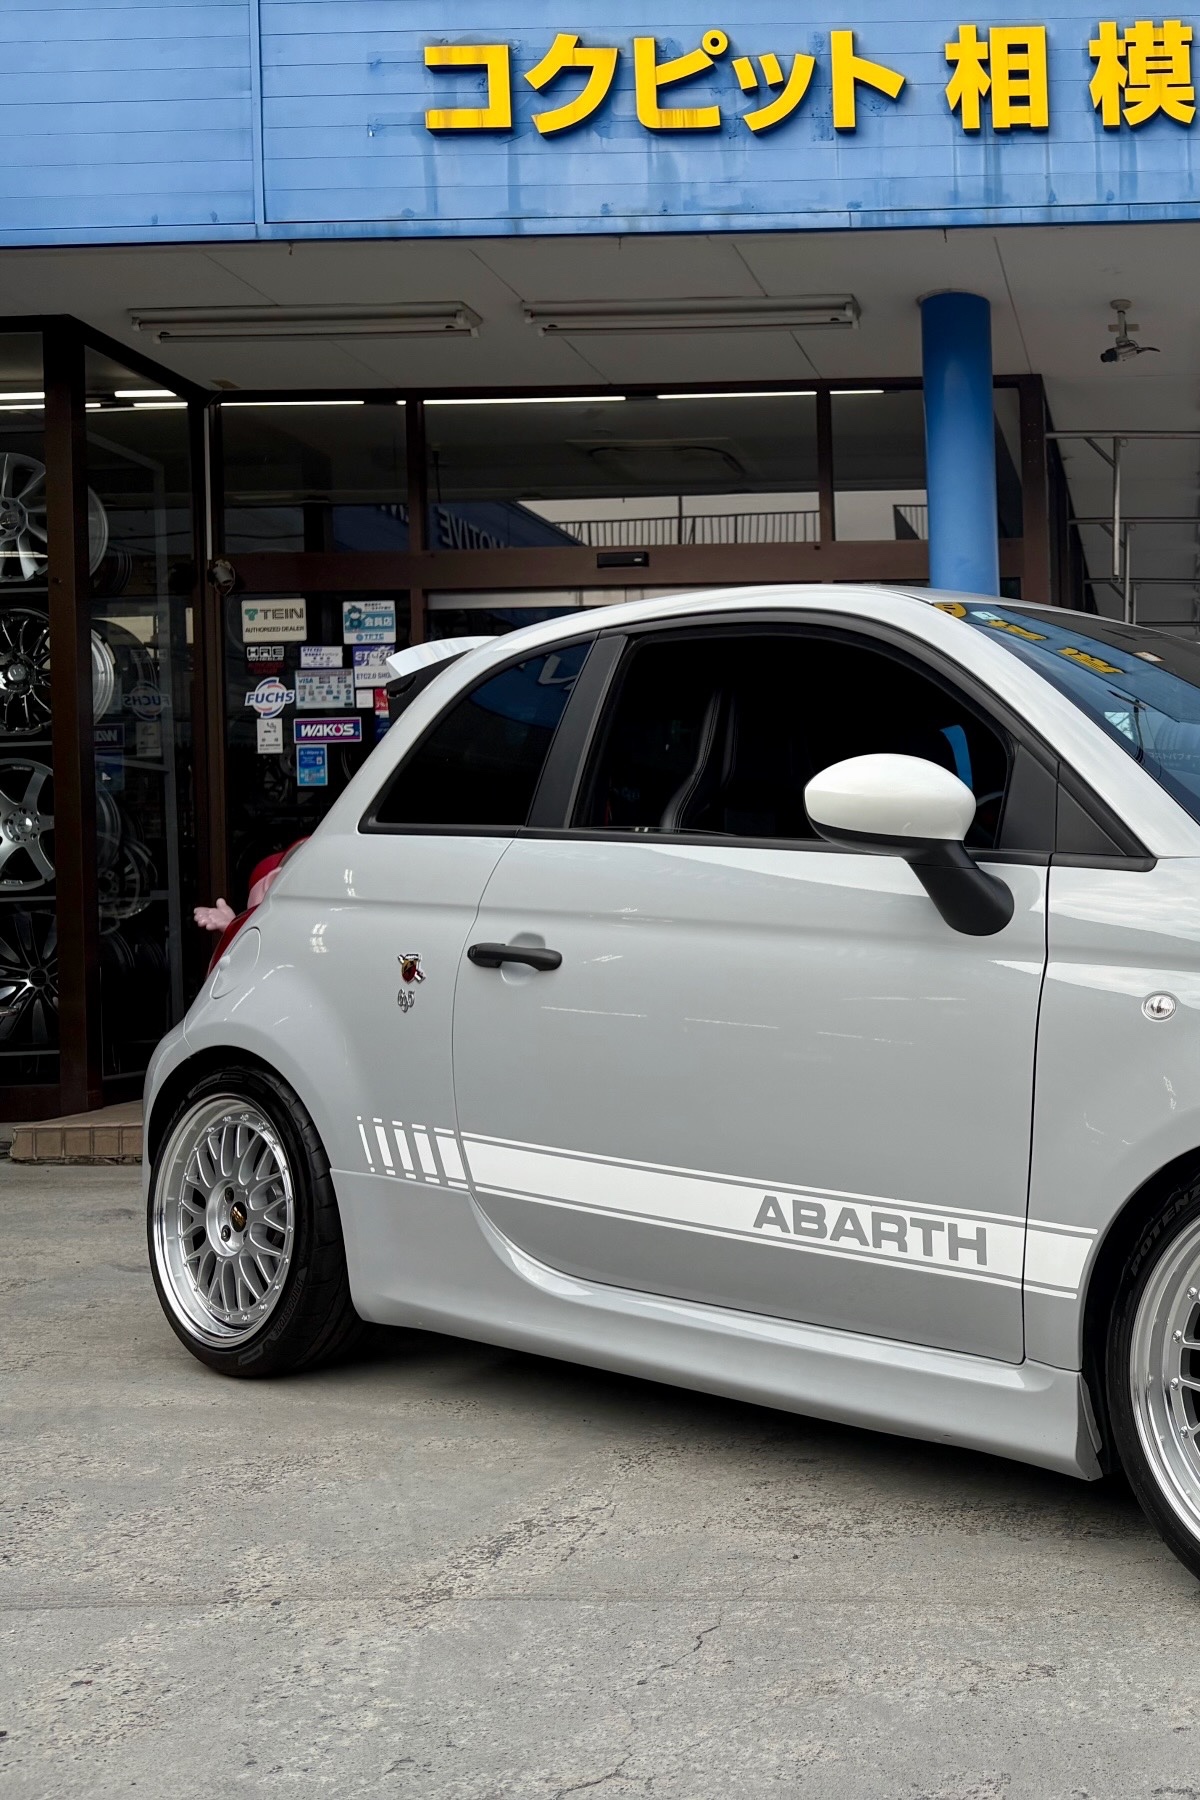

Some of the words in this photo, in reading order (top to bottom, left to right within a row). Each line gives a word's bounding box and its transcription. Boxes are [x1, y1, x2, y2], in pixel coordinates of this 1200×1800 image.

[423, 30, 906, 136] コクピット
[260, 608, 304, 620] TEIN
[246, 692, 294, 704] FUCHS
[753, 1195, 987, 1266] ABARTH
